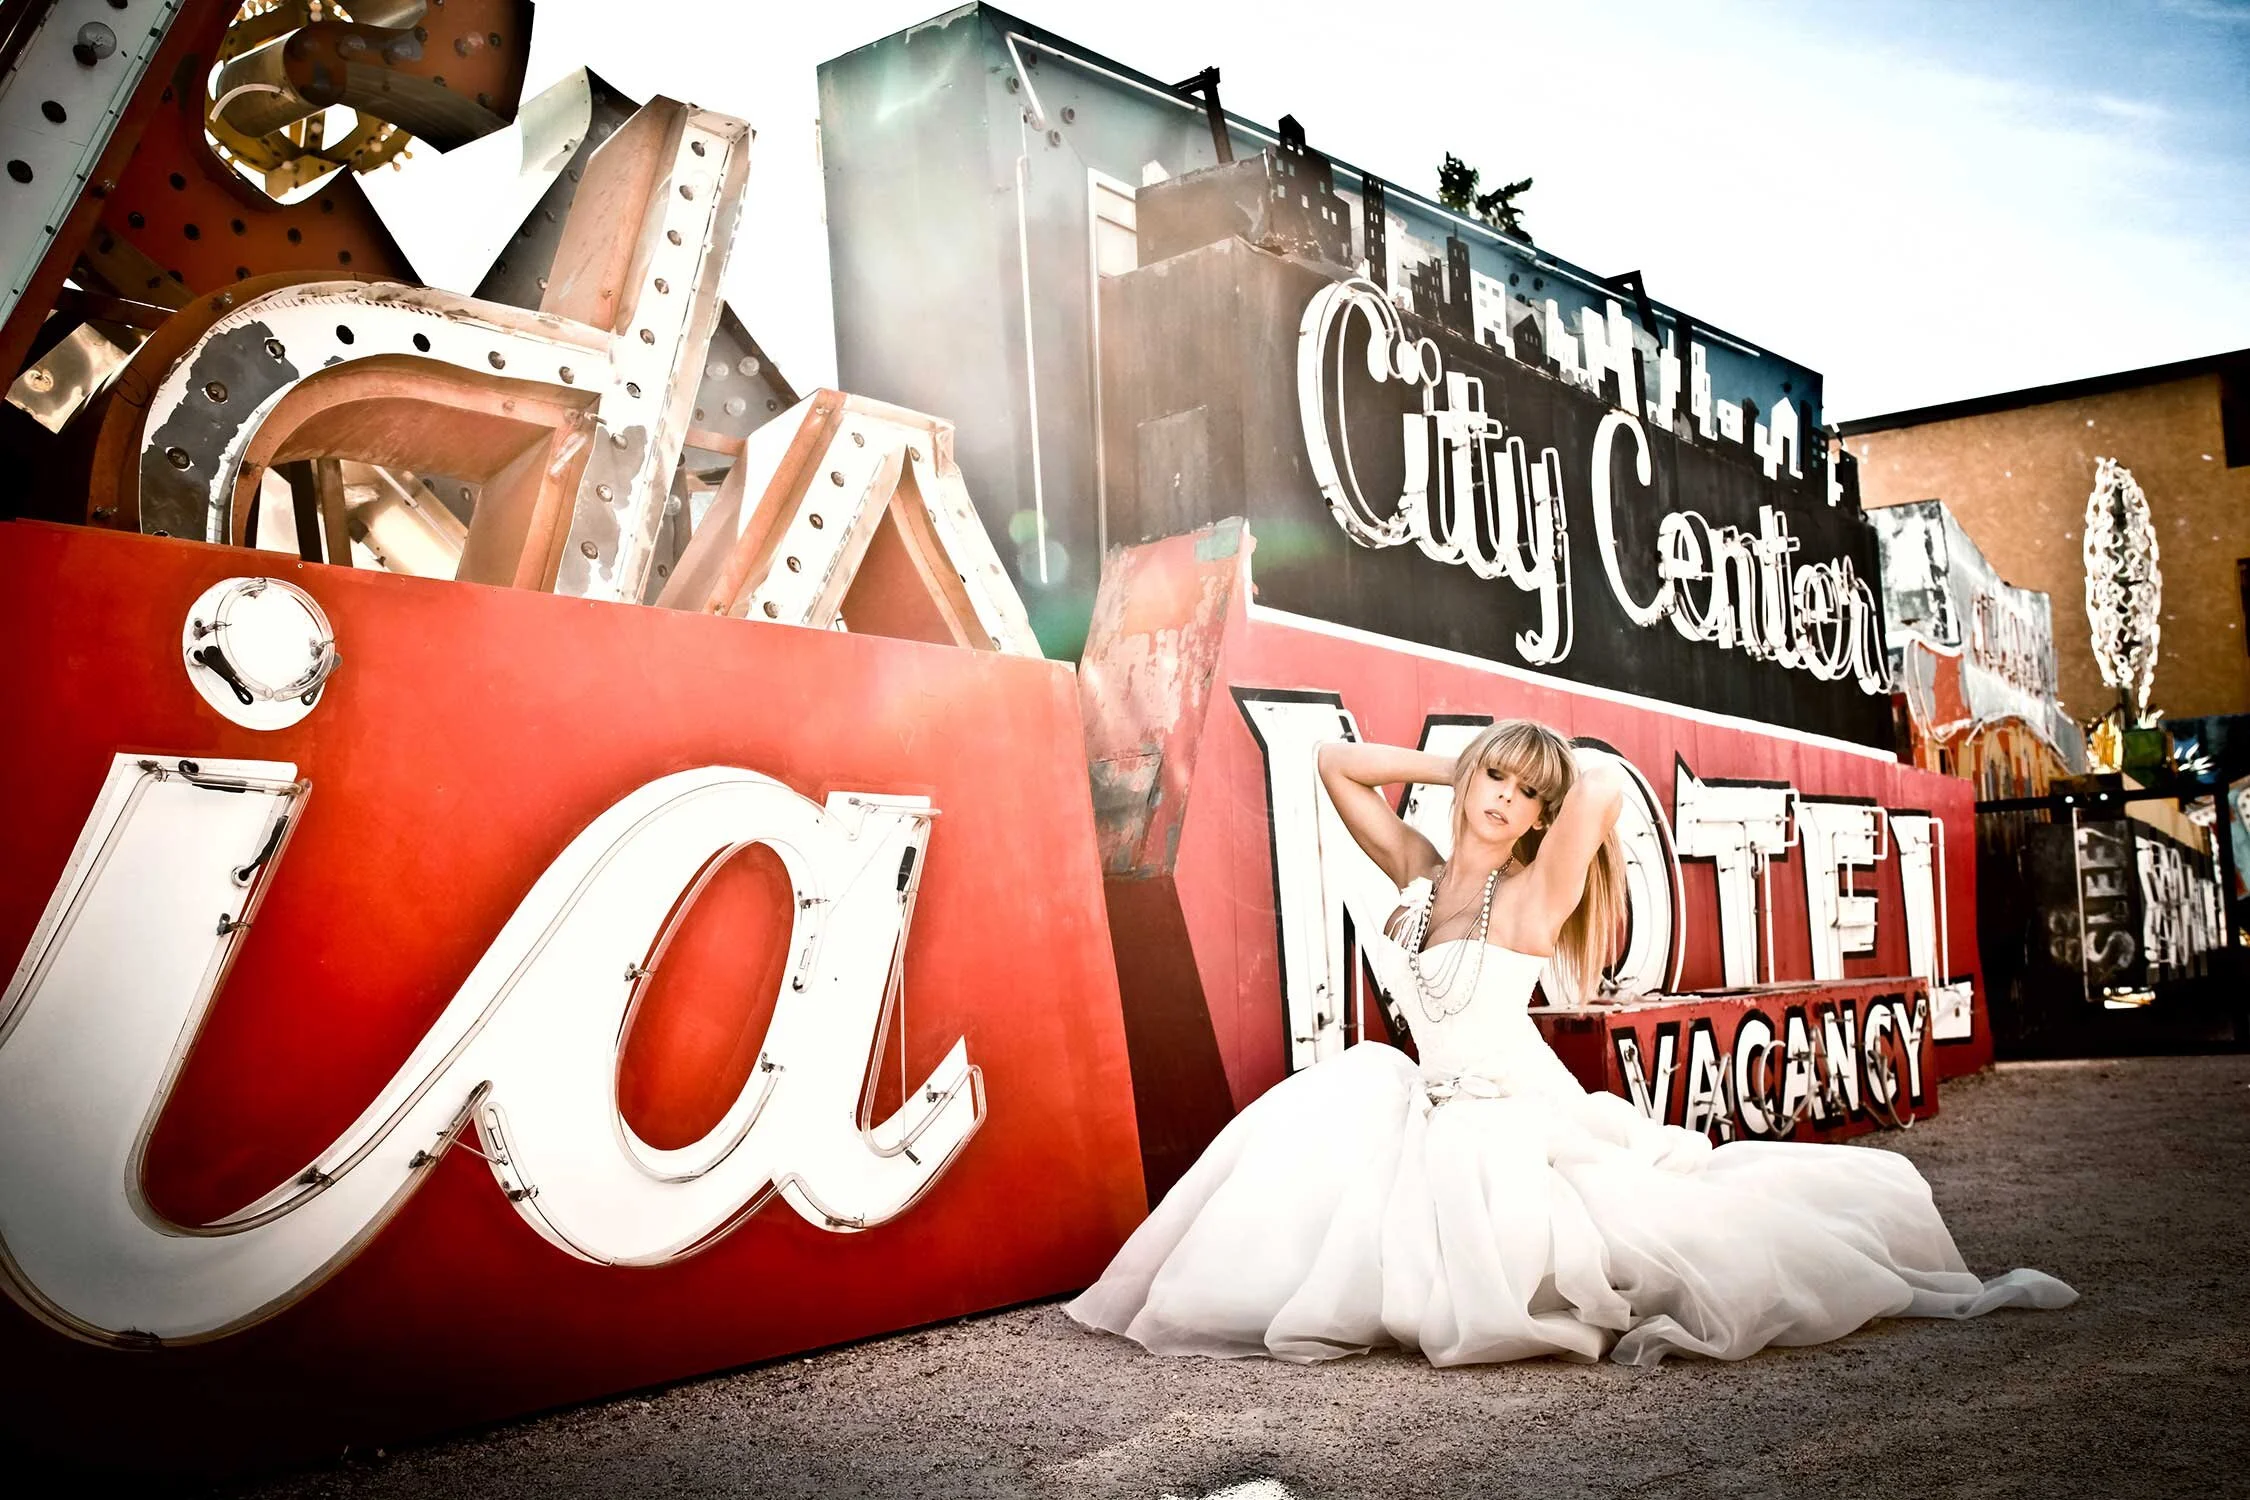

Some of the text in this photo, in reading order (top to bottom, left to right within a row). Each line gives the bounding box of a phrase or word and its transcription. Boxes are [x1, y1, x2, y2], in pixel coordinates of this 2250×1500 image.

[1298, 278, 1573, 666] City
[1592, 409, 1892, 695] Center
[1614, 996, 1929, 1142] VACANCY
